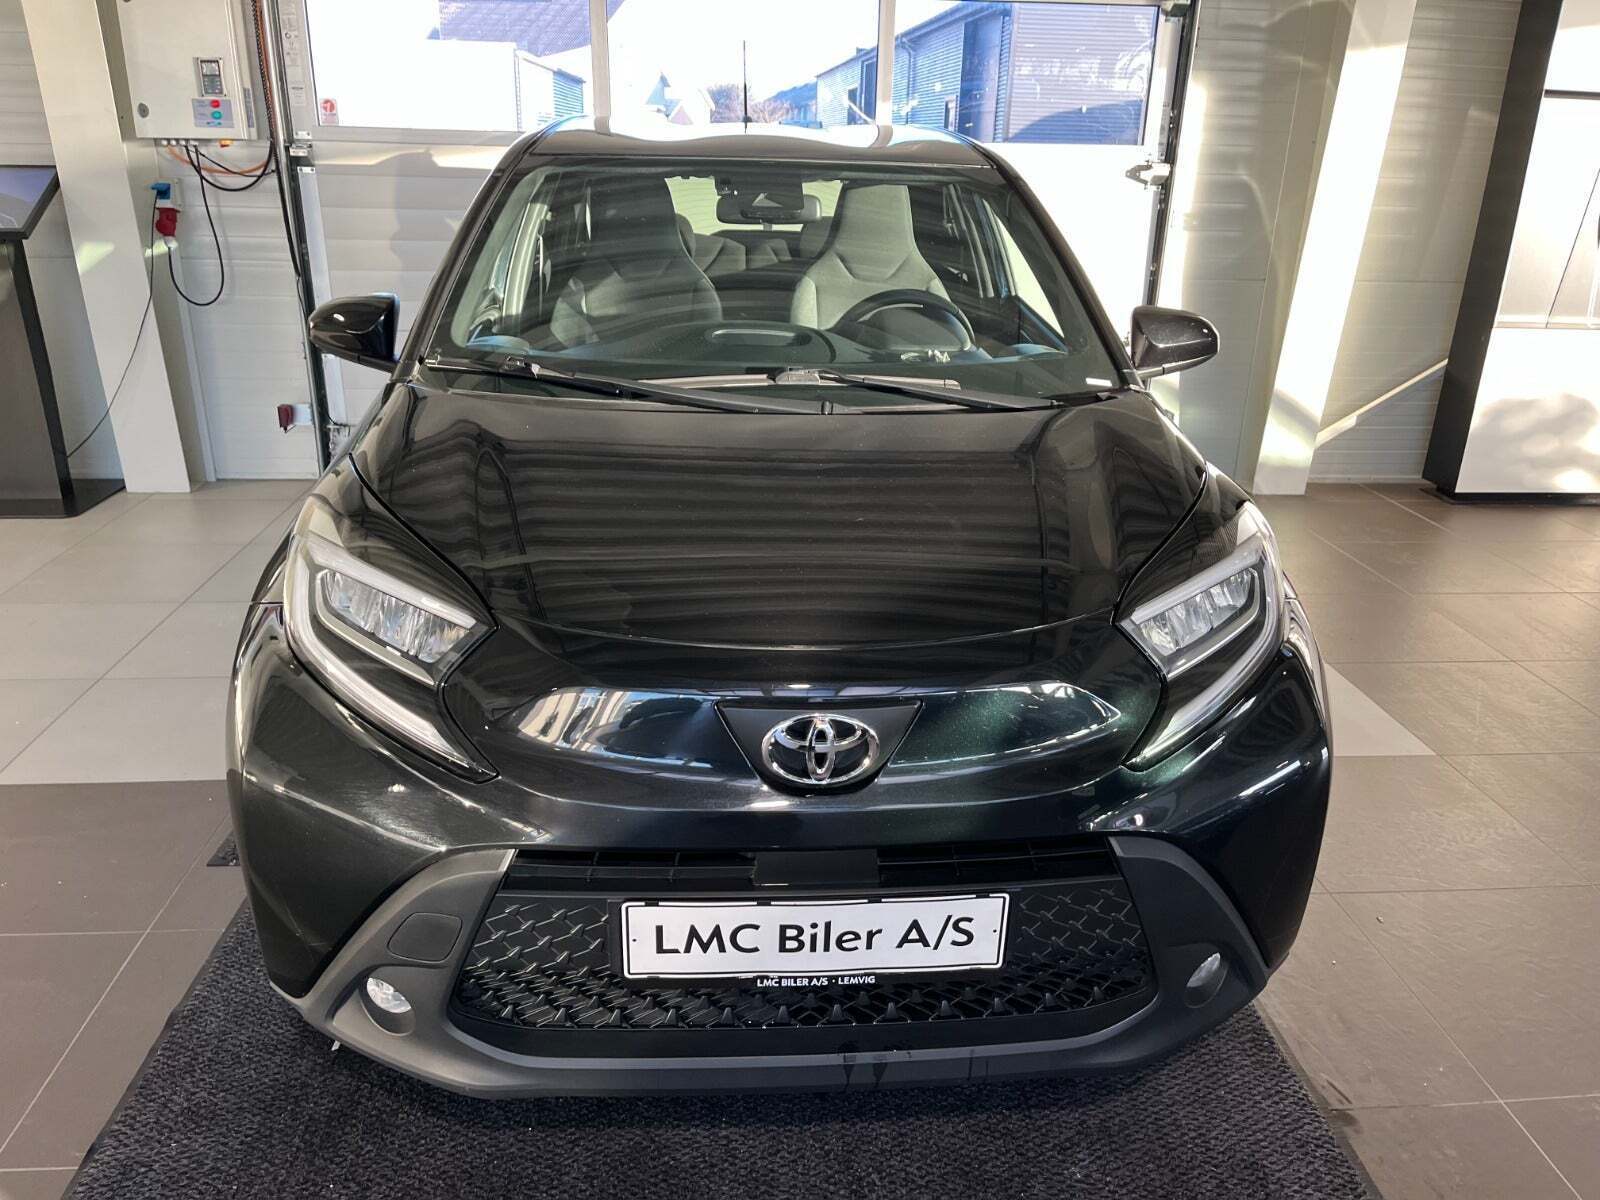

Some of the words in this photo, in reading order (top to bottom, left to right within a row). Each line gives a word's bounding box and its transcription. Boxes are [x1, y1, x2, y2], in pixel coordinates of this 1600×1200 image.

[655, 924, 760, 954] LMC
[778, 920, 883, 953] Biler
[895, 914, 975, 951] A/S
[757, 978, 779, 987] LMC
[781, 978, 809, 987] BILER
[810, 977, 828, 986] A/S
[838, 975, 876, 985] LEMVIG
